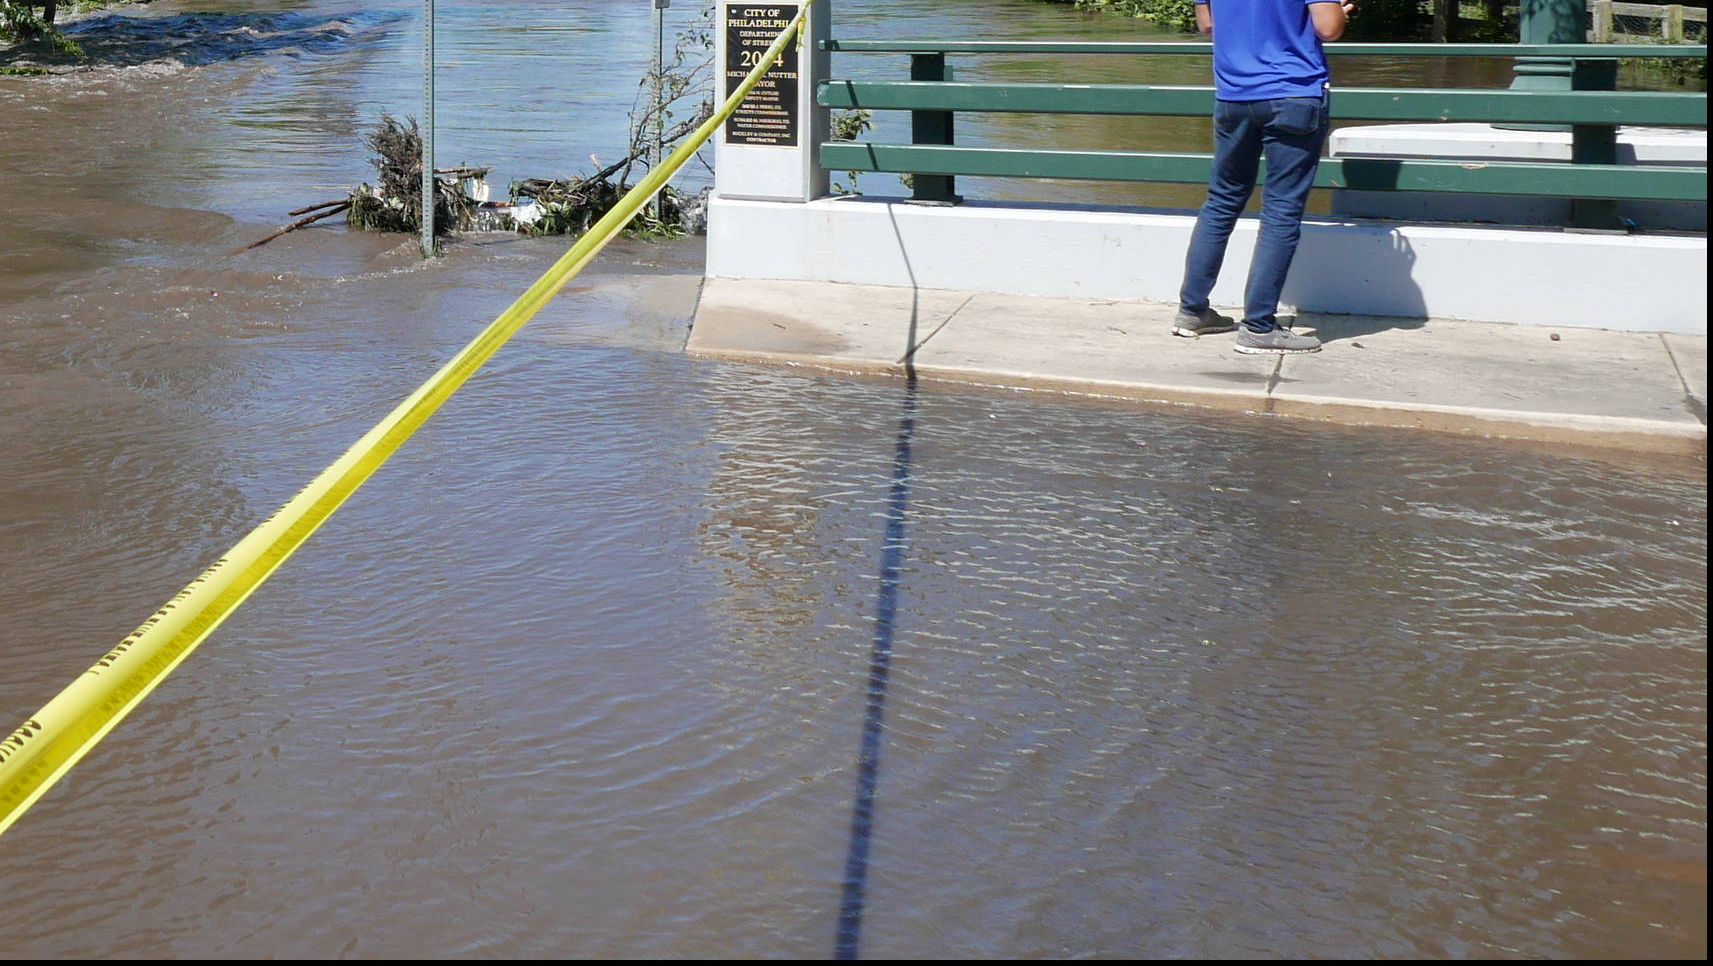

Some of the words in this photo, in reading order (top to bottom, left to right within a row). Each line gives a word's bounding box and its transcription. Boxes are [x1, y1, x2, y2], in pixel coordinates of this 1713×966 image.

[744, 8, 767, 17] CITY
[767, 9, 780, 17] OF
[728, 19, 790, 28] PHILADELPHI
[739, 30, 782, 38] DEPARTMEN
[740, 50, 784, 67] 204
[768, 71, 798, 79] NUTTER
[754, 80, 776, 88] AYOR
